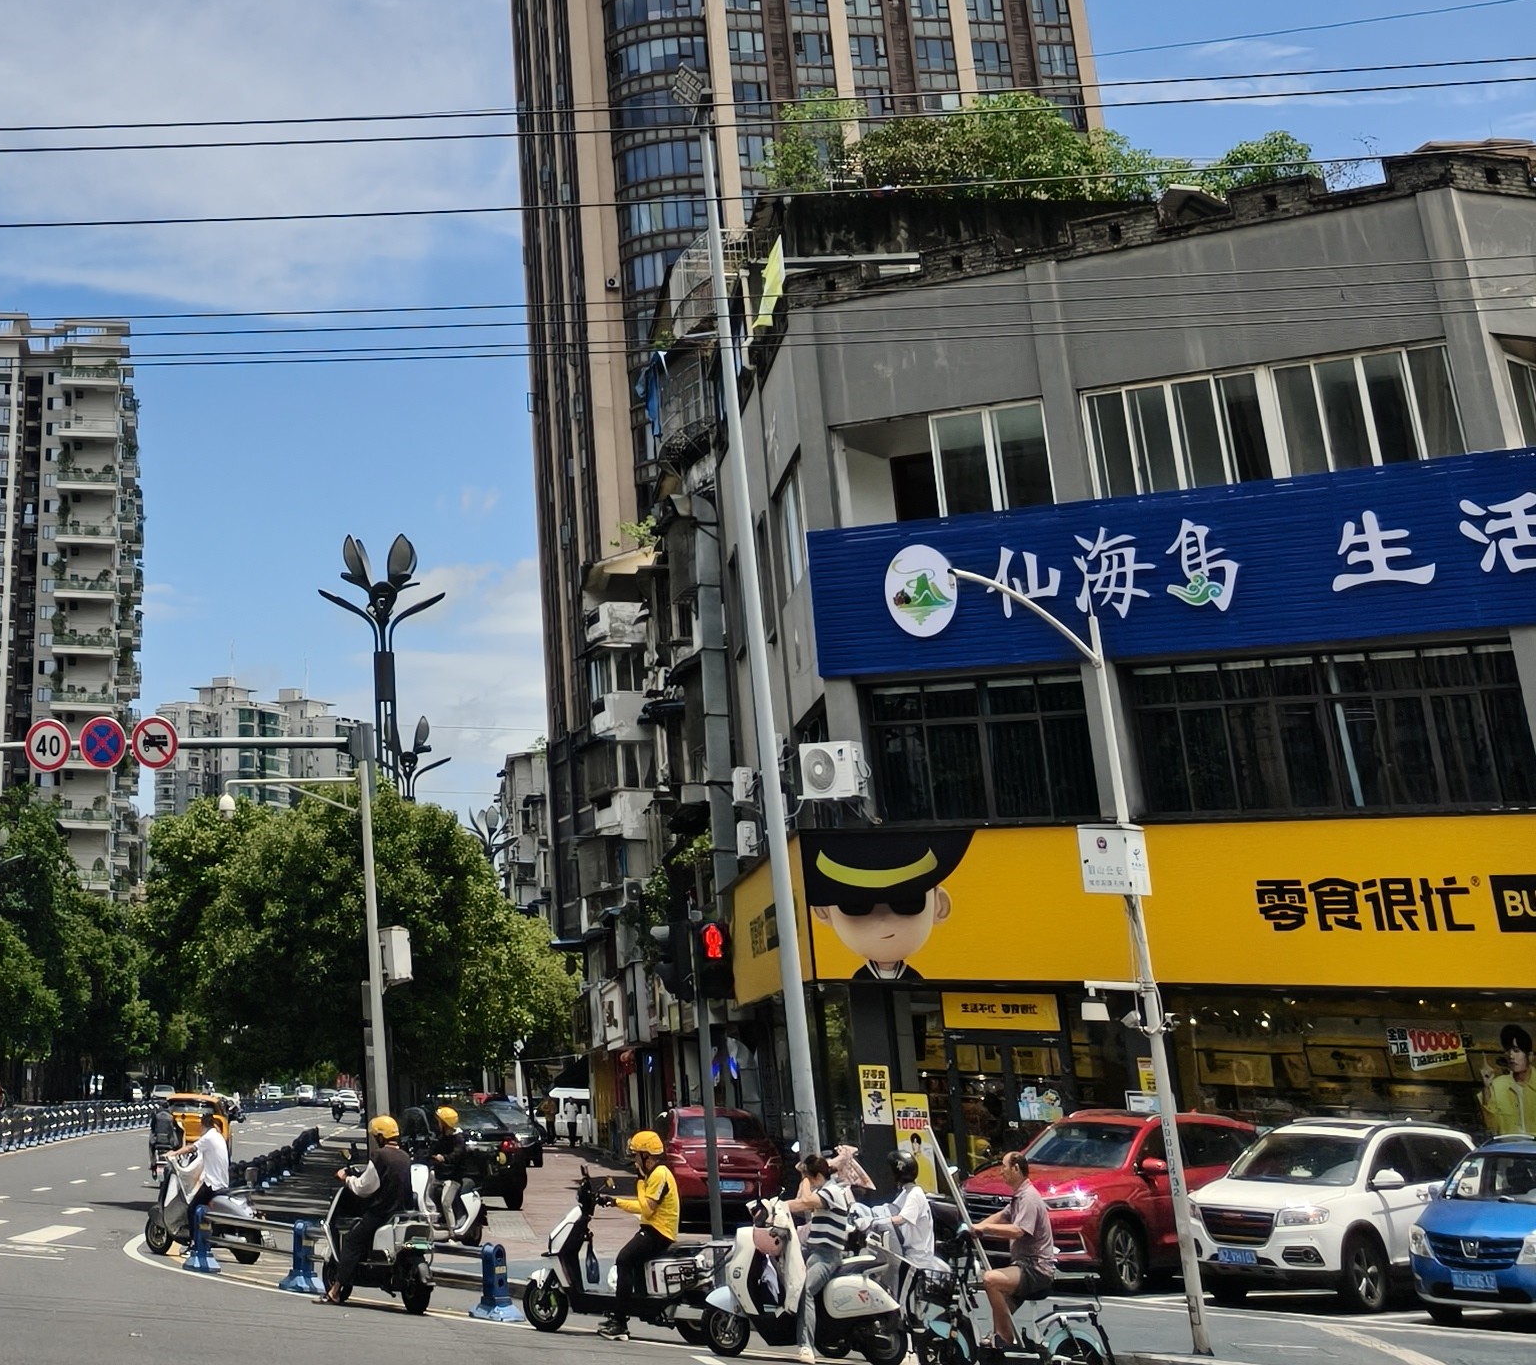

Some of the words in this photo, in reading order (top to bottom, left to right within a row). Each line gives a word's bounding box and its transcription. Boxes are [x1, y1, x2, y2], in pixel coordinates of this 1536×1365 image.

[35, 734, 61, 757] 40
[1256, 876, 1476, 932] 零食很忙
